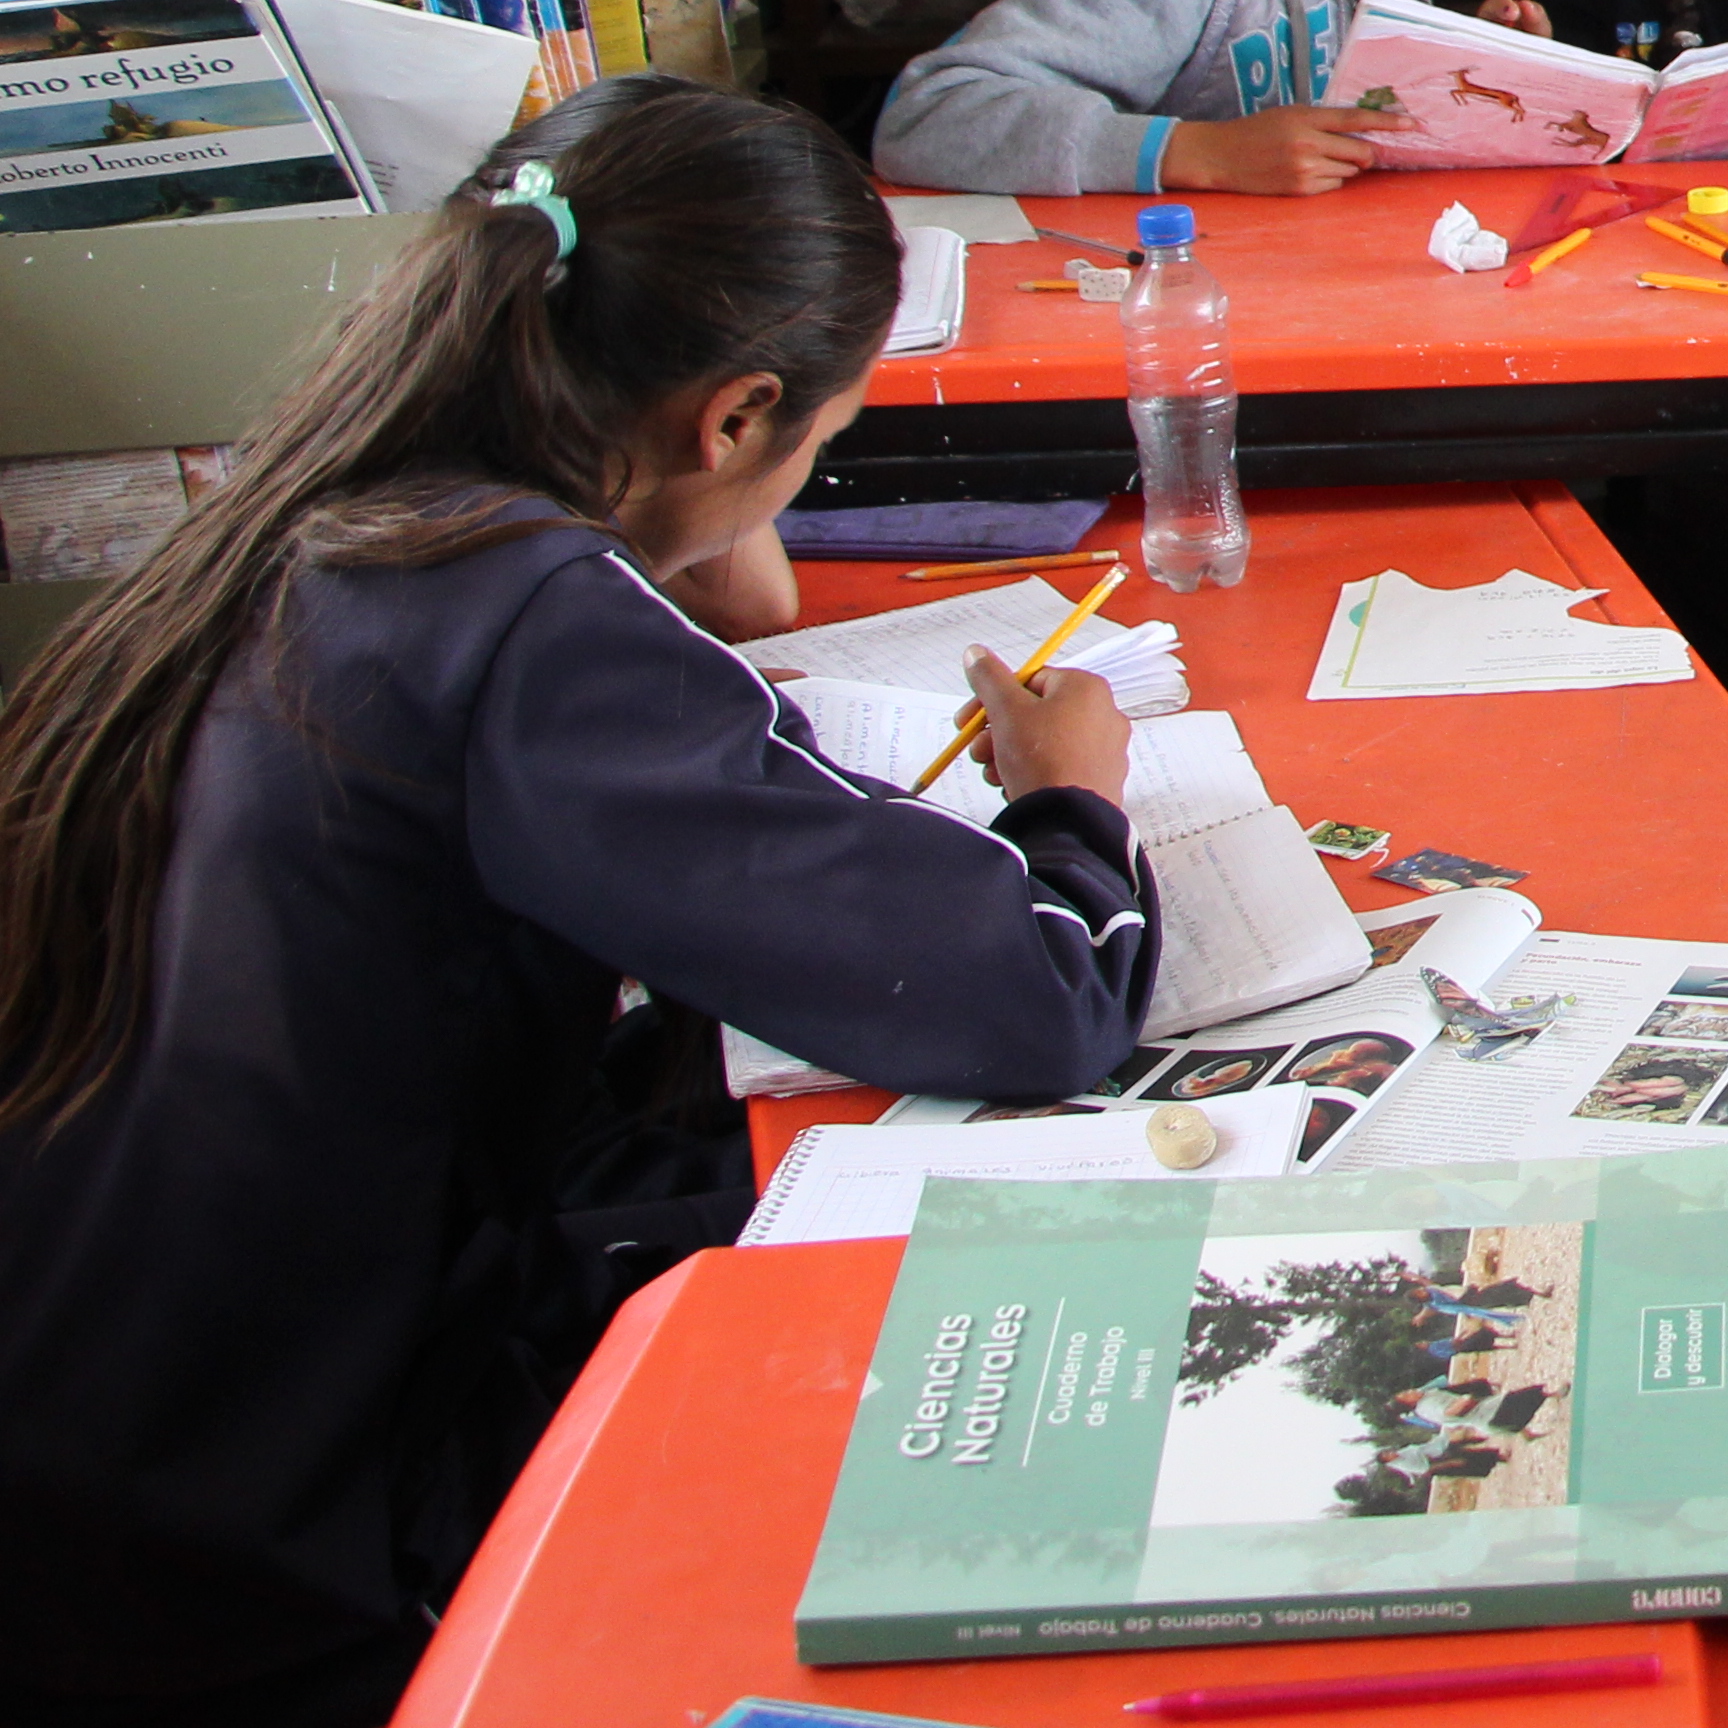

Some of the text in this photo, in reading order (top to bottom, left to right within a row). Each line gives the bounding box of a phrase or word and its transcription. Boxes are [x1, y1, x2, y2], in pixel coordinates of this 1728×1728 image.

[79, 54, 235, 91] refugio
[0, 142, 228, 185] oberto Innocenti
[1653, 1319, 1677, 1379] Dialogar
[1684, 1308, 1706, 1386] y descubrir
[899, 1312, 973, 1459] Ciencias
[951, 1302, 1027, 1465] Naturales
[1048, 1331, 1088, 1425] Cuaderno
[1085, 1325, 1128, 1427] de Trabajo
[1130, 1364, 1152, 1401] Nivel
[1037, 1618, 1120, 1638] Trabajo
[1123, 1616, 1152, 1633] de
[1158, 1612, 1262, 1629] Cuaderno
[1381, 1601, 1471, 1621] Ciencias
